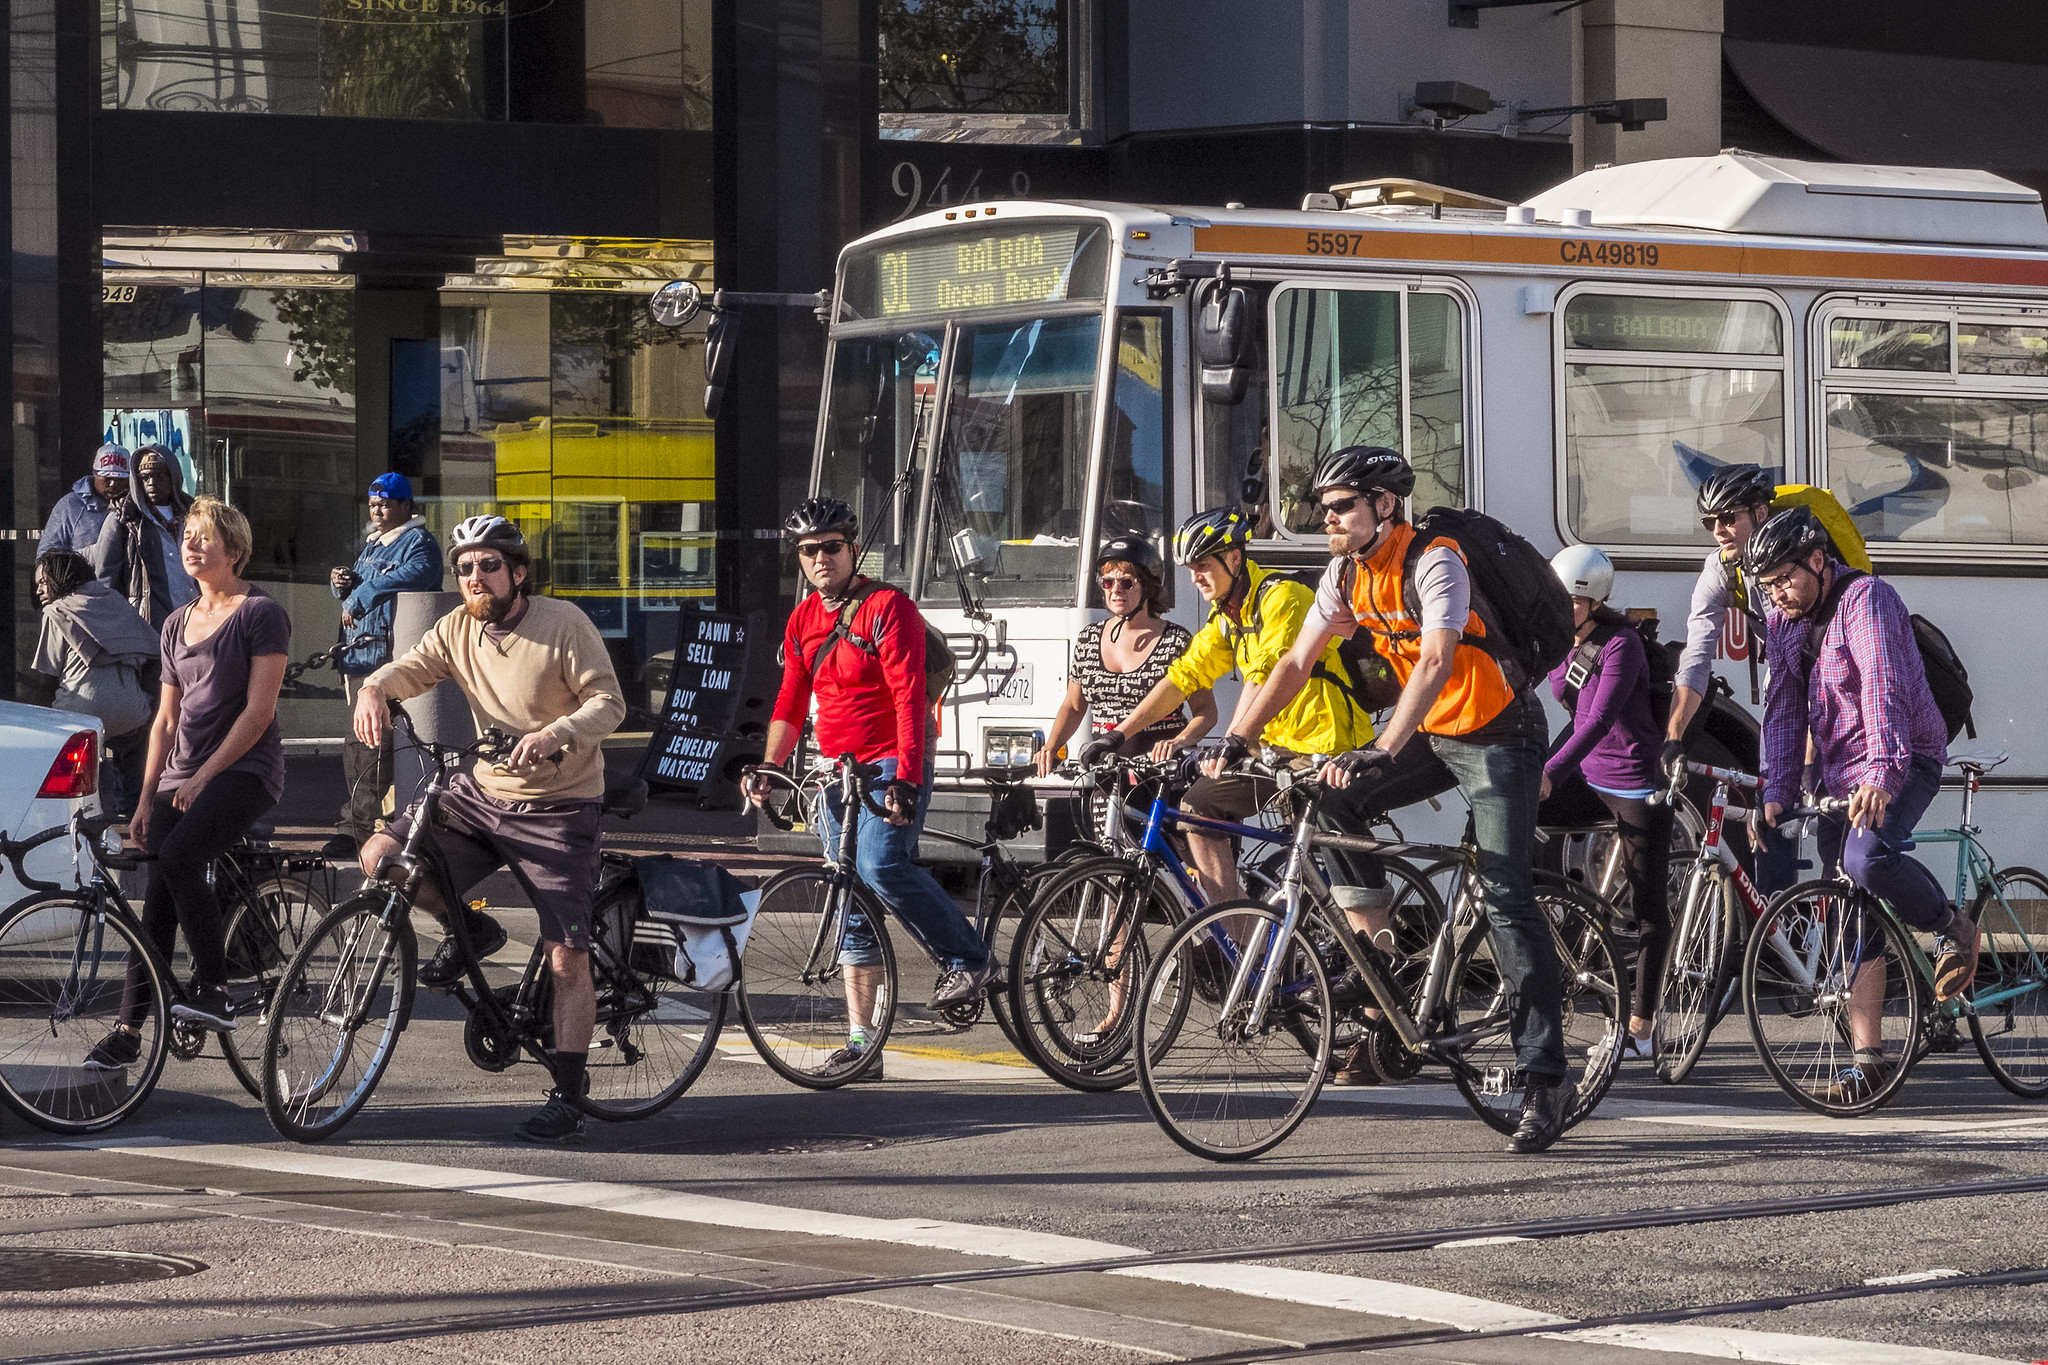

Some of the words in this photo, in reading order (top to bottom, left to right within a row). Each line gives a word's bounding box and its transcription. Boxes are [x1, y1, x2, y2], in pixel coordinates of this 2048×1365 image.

[1306, 232, 1363, 255] 5597
[1560, 240, 1659, 267] CA49819
[882, 252, 911, 314] 31
[958, 236, 1044, 274] BALBOA
[103, 287, 134, 301] 948
[938, 279, 995, 309] Ocean
[1613, 316, 1708, 339] BALBOA
[698, 621, 731, 642] PAWN
[687, 642, 713, 665] SELL
[701, 668, 731, 690] LOAN
[672, 688, 697, 710] BUY
[666, 735, 719, 759] JEWELRY
[657, 756, 710, 781] WATCHES
